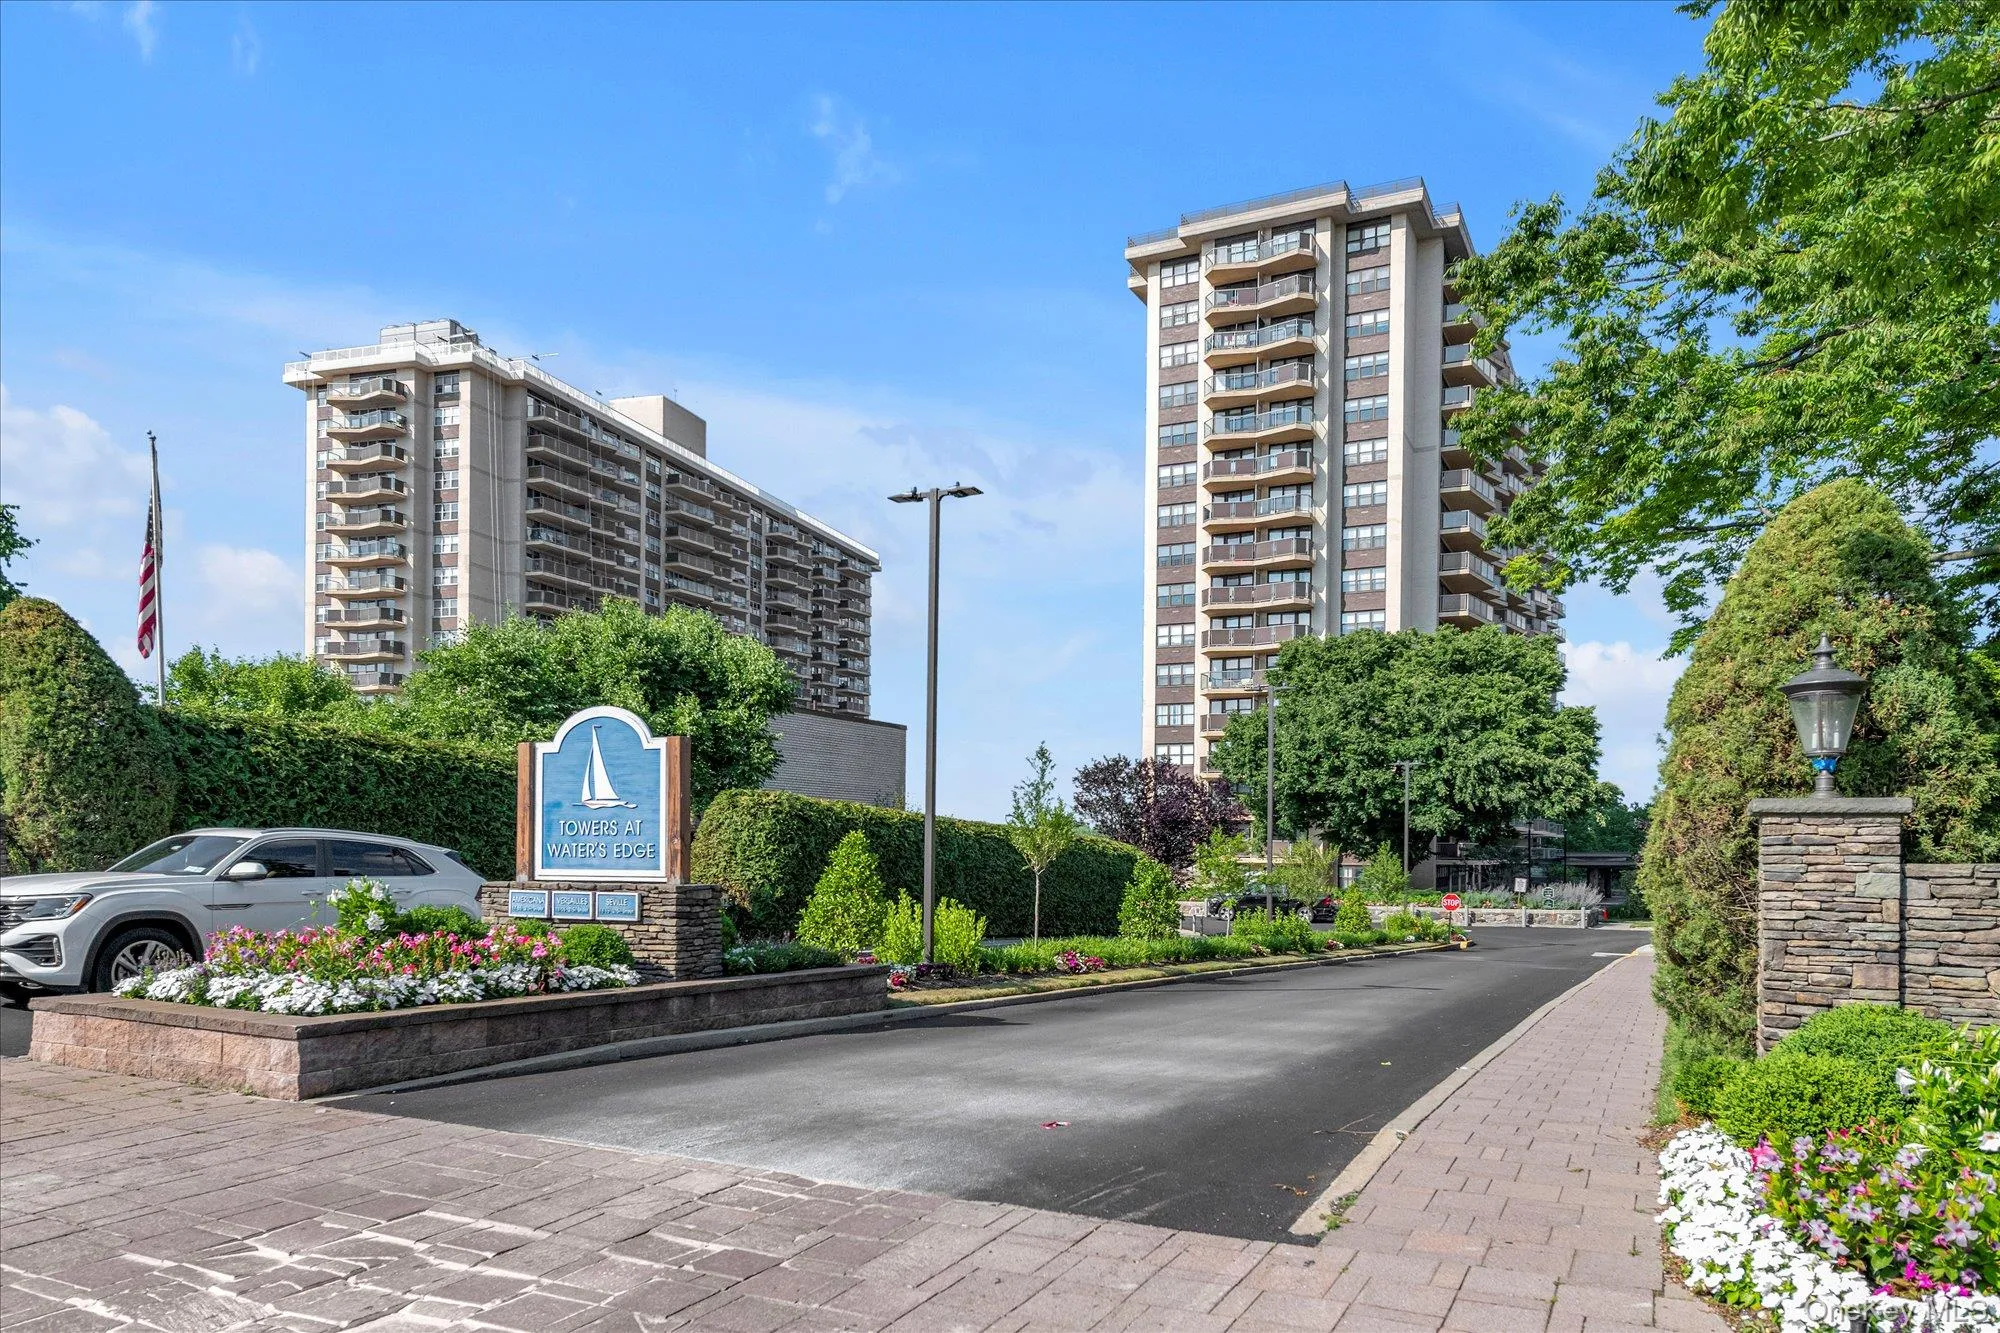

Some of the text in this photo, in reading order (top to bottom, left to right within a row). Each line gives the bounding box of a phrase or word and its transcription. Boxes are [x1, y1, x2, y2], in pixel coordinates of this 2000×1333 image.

[559, 820, 642, 836] TOWERS AT
[547, 842, 656, 858] WATER'S EDGE
[606, 898, 629, 906] SEVILLE
